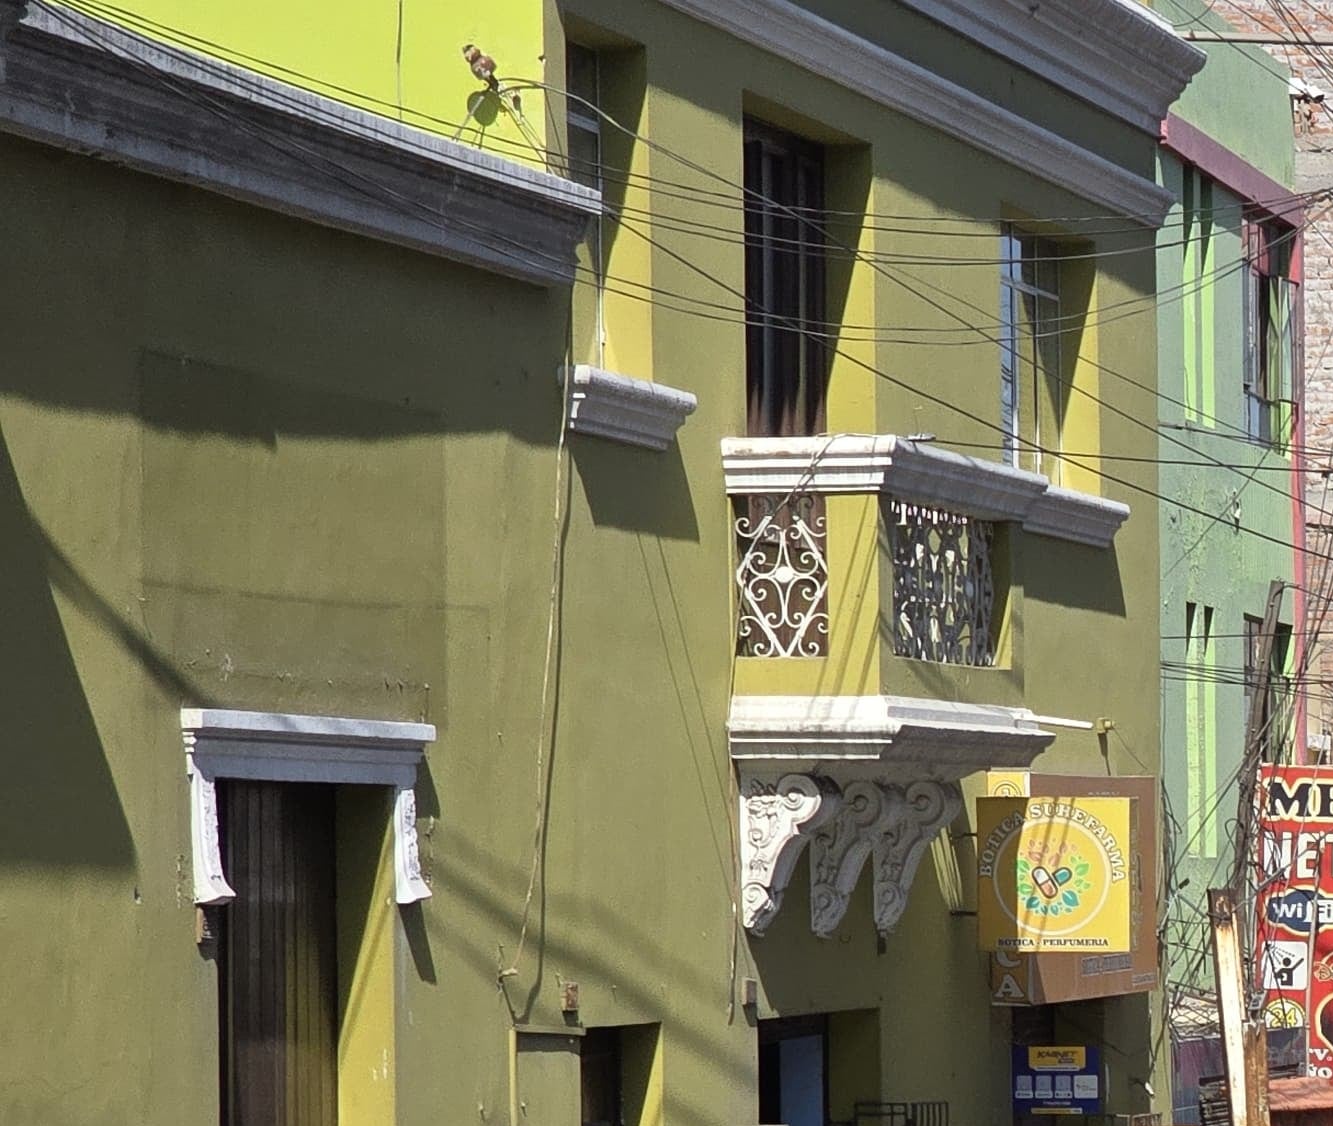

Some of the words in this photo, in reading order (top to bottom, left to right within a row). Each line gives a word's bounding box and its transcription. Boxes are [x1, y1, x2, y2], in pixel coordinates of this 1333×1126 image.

[979, 810, 1026, 878] BOTICA
[1029, 803, 1127, 883] SUHEFARMA
[998, 938, 1035, 947] BOTICA
[1042, 938, 1109, 947] PERFUMERIA
